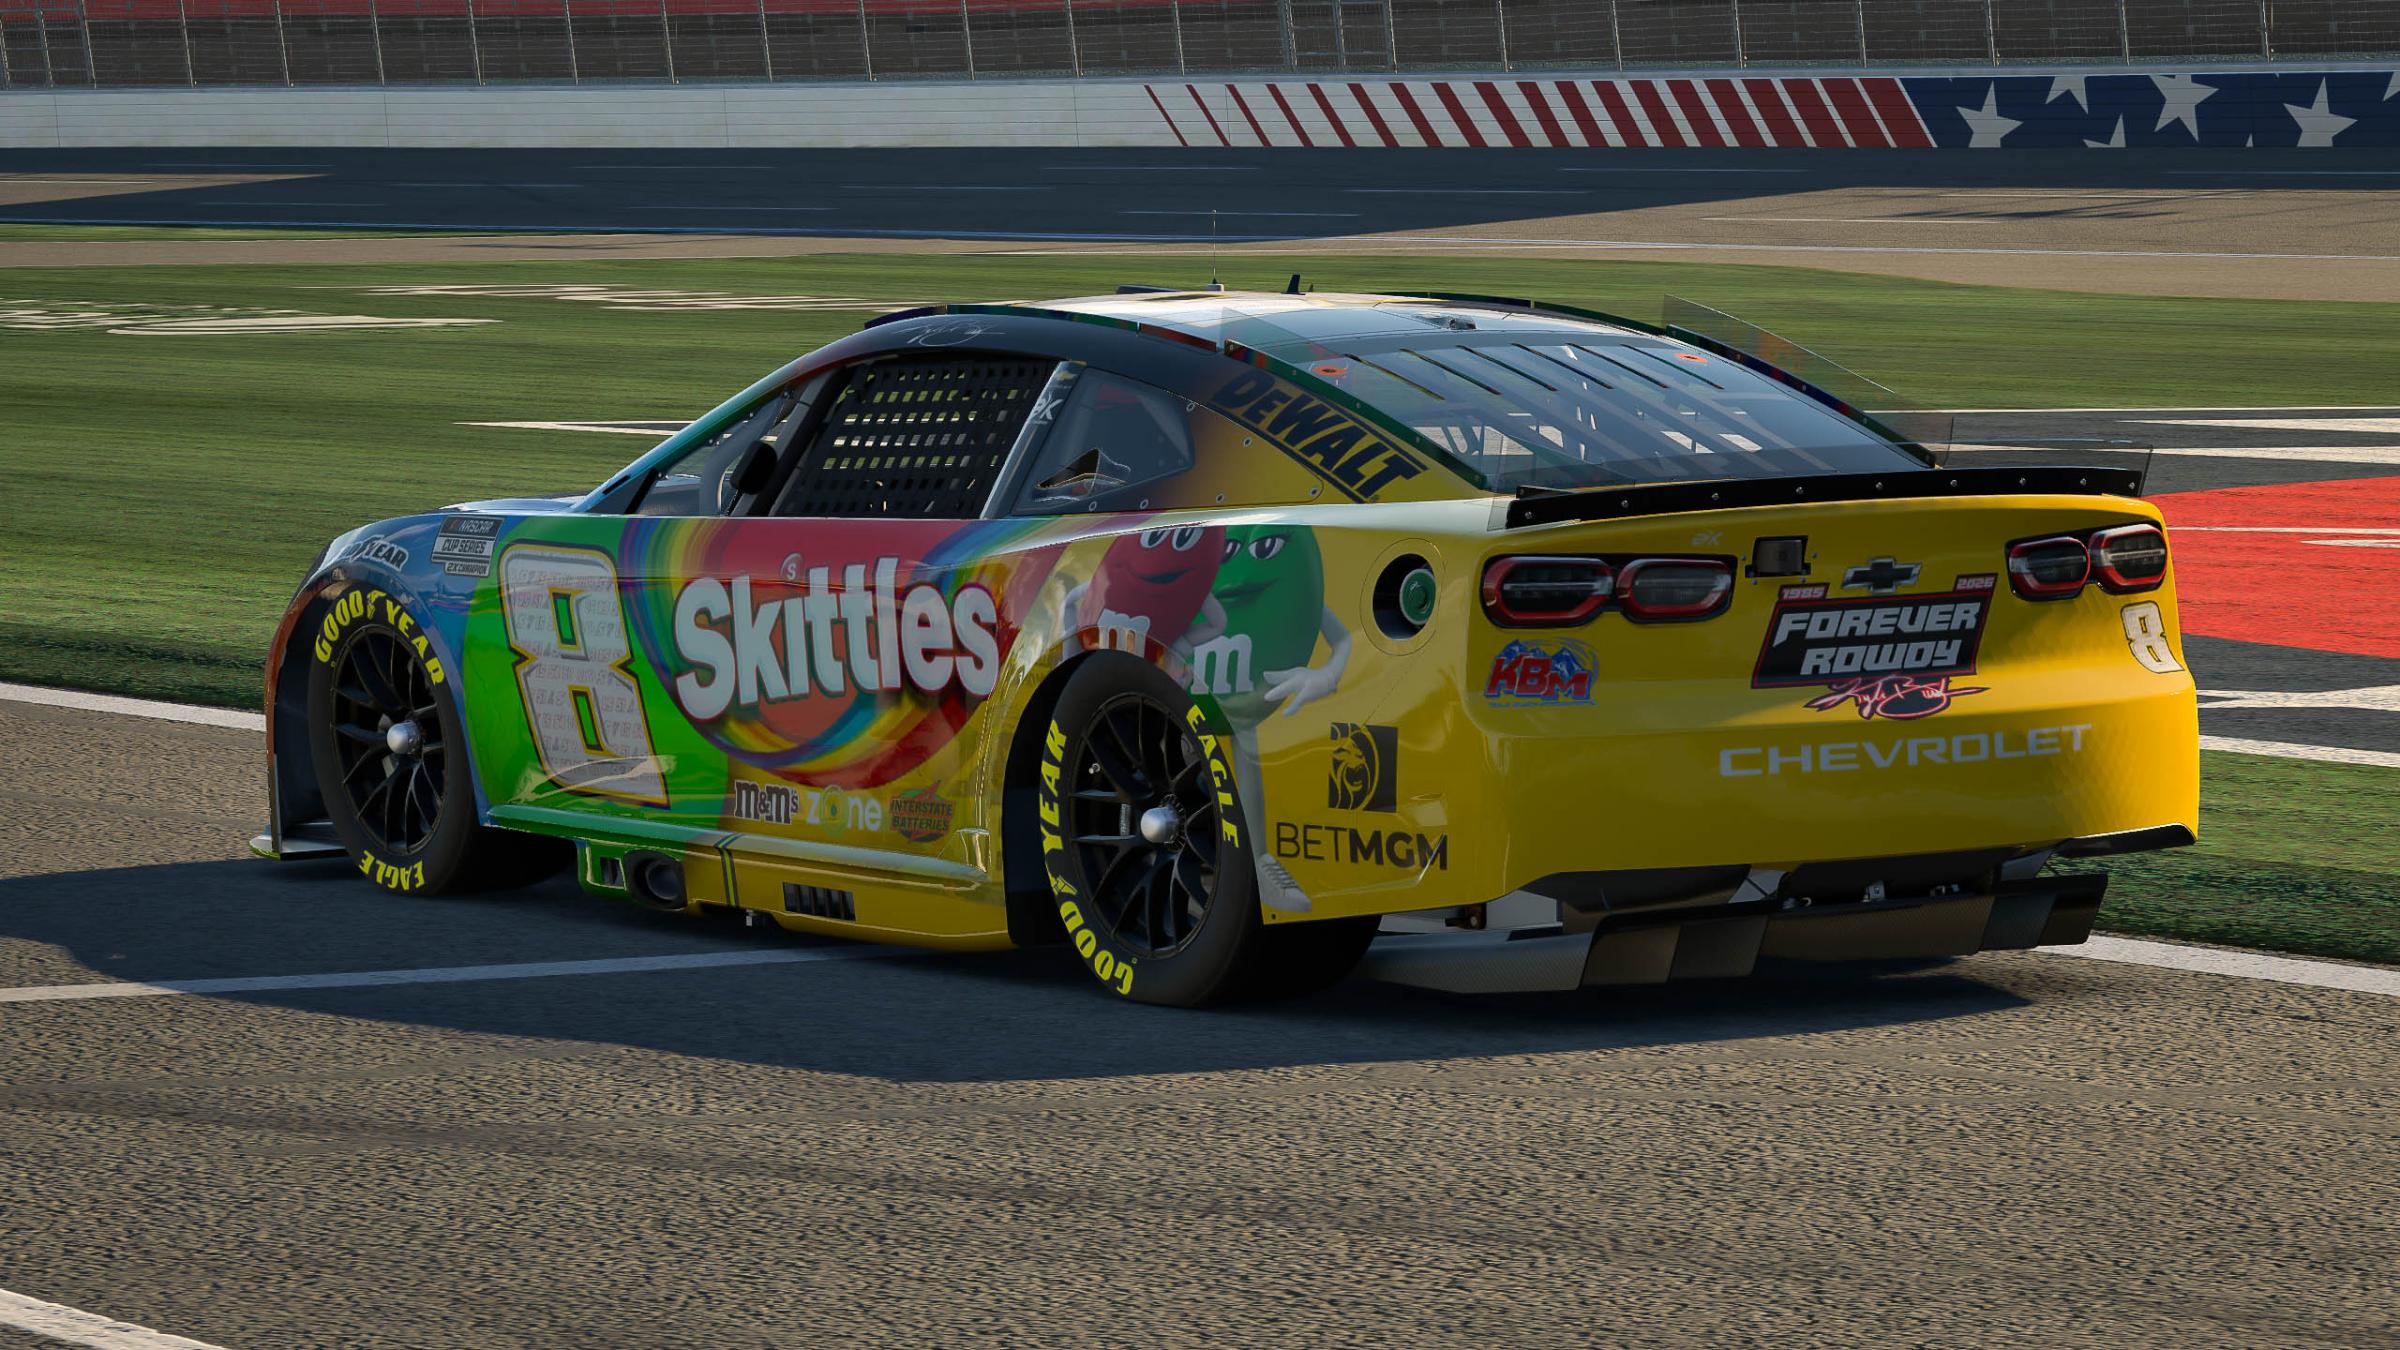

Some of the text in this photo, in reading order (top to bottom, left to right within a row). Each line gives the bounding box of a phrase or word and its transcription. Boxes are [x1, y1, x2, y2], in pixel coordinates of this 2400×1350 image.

[442, 538, 487, 554] CUP SERIES
[459, 519, 494, 533] NASCAR
[1782, 586, 1825, 600] 1985
[675, 557, 1000, 721] Skittles
[1773, 602, 1981, 648] FOREVER
[2120, 599, 2185, 675] 8
[498, 541, 672, 810] 8
[1484, 652, 1591, 699] KBM
[1799, 640, 1962, 675] ROWDY
[1719, 723, 2092, 777] CHEVROLET
[1186, 704, 1239, 848] EAGLE
[890, 798, 953, 817] INTERSTATE
[892, 815, 949, 832] BATTERIES
[1276, 822, 1449, 871] BETMGM
[358, 849, 425, 893] EAGLE
